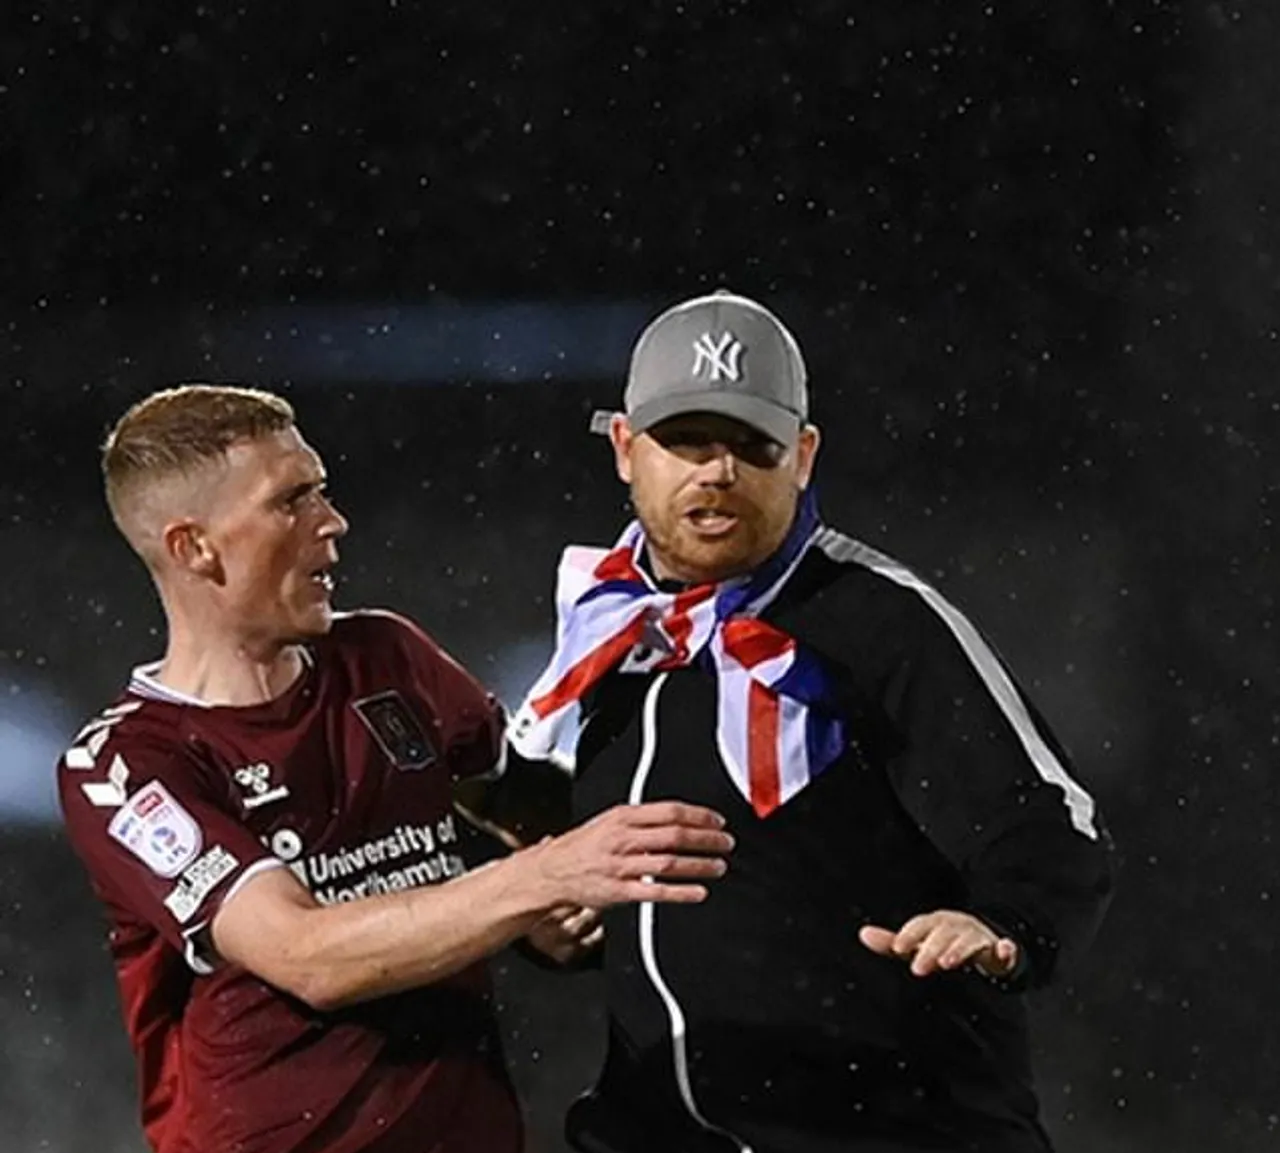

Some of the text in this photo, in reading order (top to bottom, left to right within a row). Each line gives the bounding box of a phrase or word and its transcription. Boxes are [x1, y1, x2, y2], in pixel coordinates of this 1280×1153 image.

[692, 331, 741, 381] NY
[309, 813, 457, 884] University of
